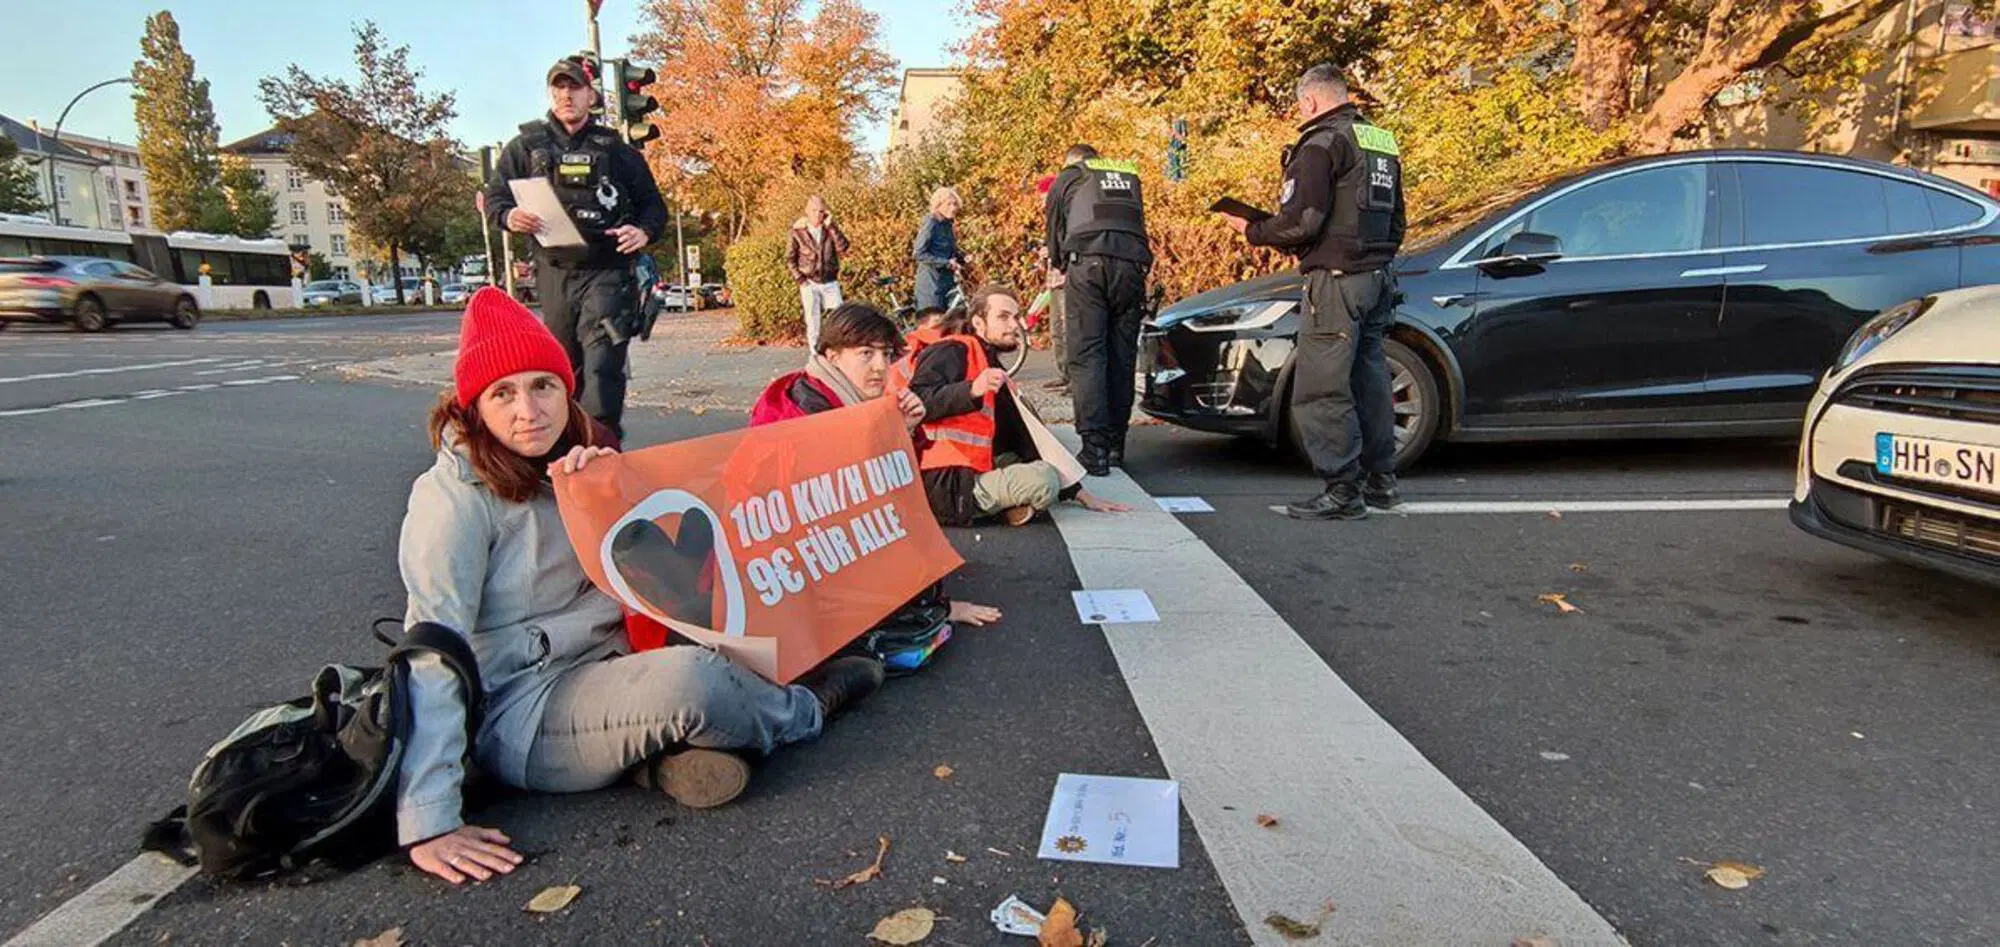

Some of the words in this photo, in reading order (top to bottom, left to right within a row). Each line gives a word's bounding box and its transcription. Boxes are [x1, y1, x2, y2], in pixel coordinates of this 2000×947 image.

[730, 489, 792, 549] 100
[791, 464, 869, 525] KM/H
[864, 449, 914, 496] UND
[1894, 440, 1930, 474] HH
[1956, 449, 1994, 484] SN
[746, 547, 805, 606] 9€
[795, 524, 857, 582] FÜR
[850, 503, 907, 556] ALLE
